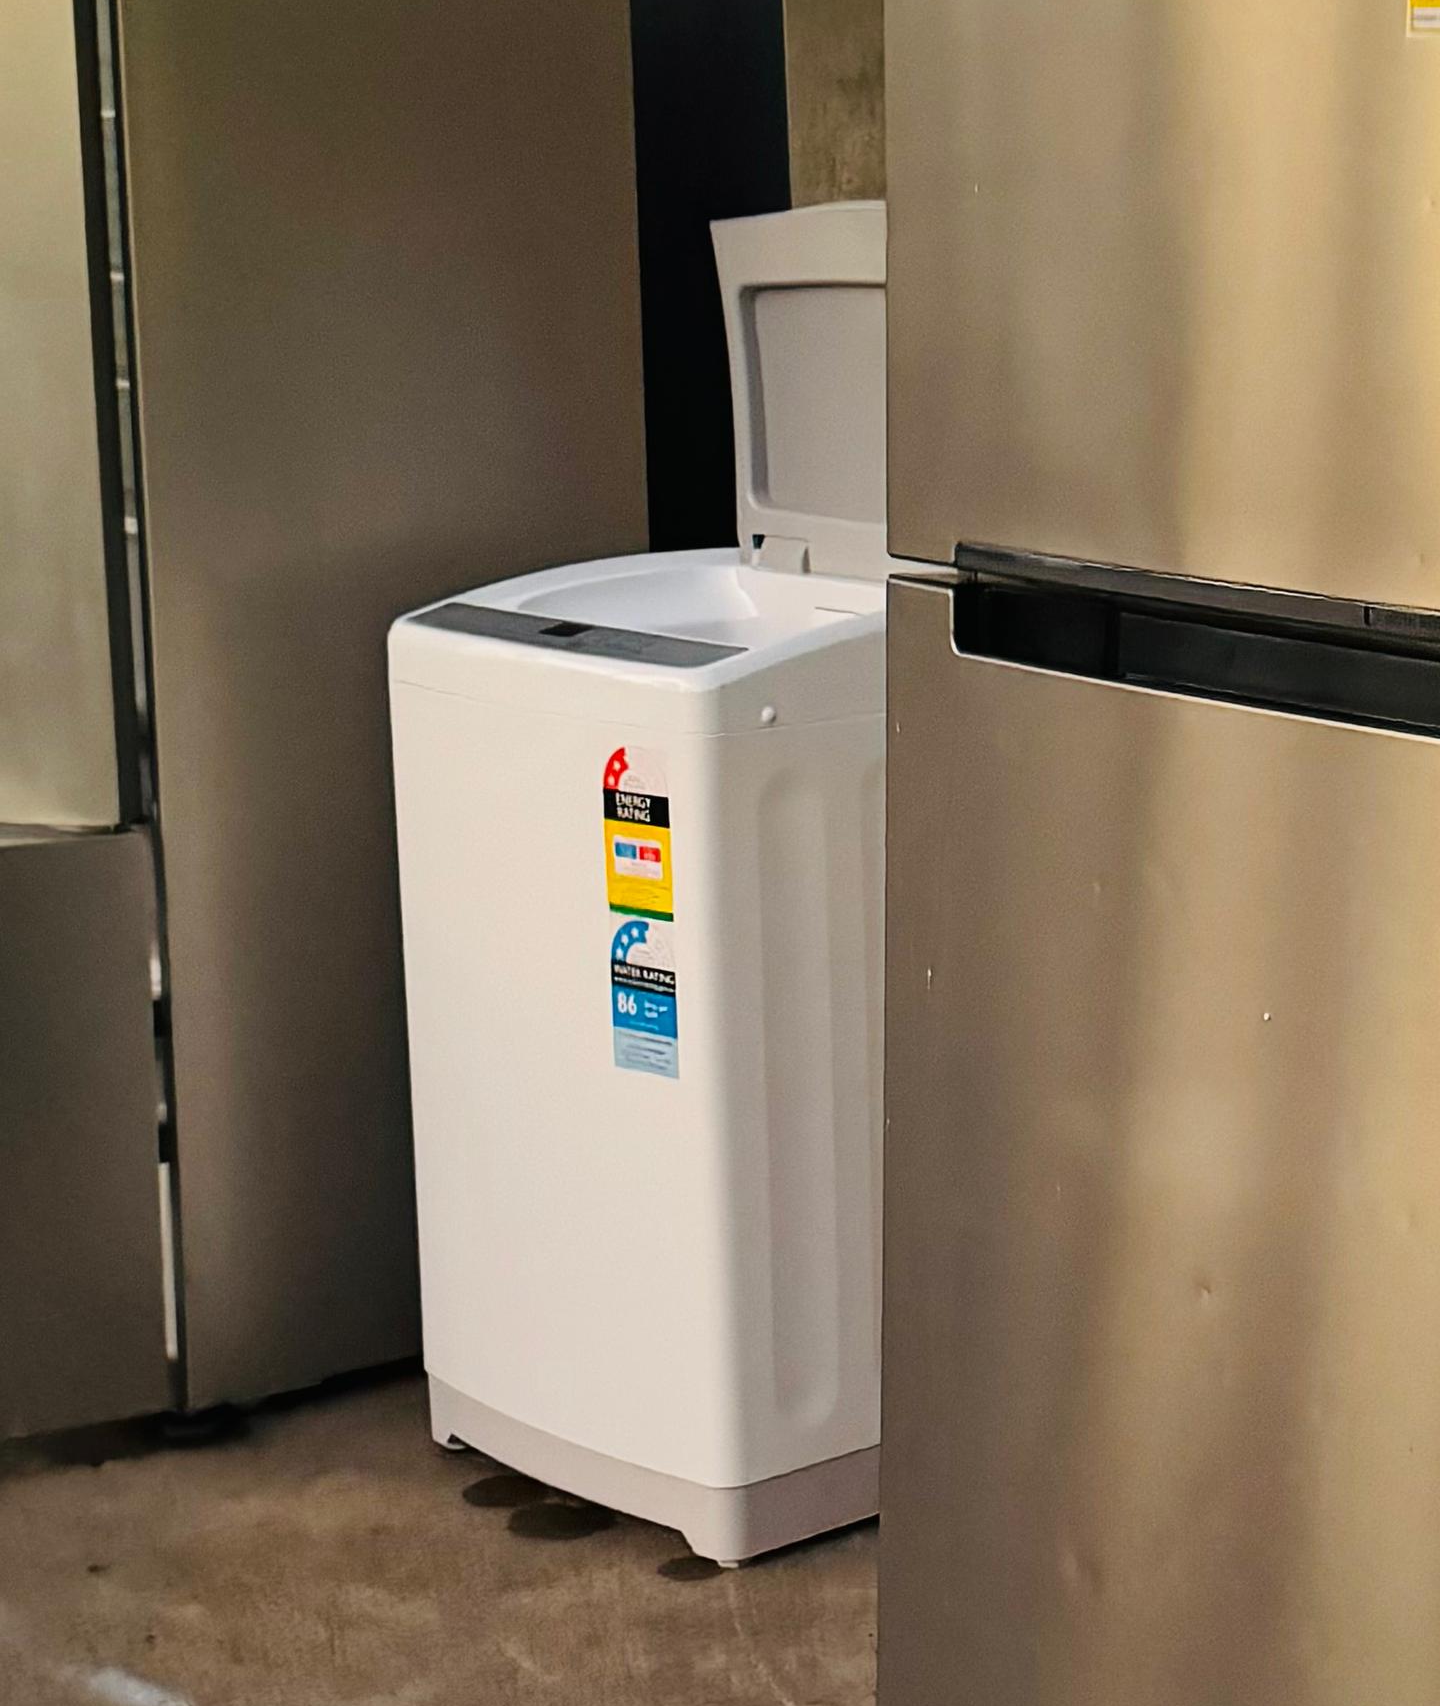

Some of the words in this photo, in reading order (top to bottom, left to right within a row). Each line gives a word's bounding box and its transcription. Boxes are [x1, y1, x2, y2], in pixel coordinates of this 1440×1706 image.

[615, 792, 651, 809] ENERGY
[616, 806, 651, 822] RATING
[617, 991, 637, 1016] 86
